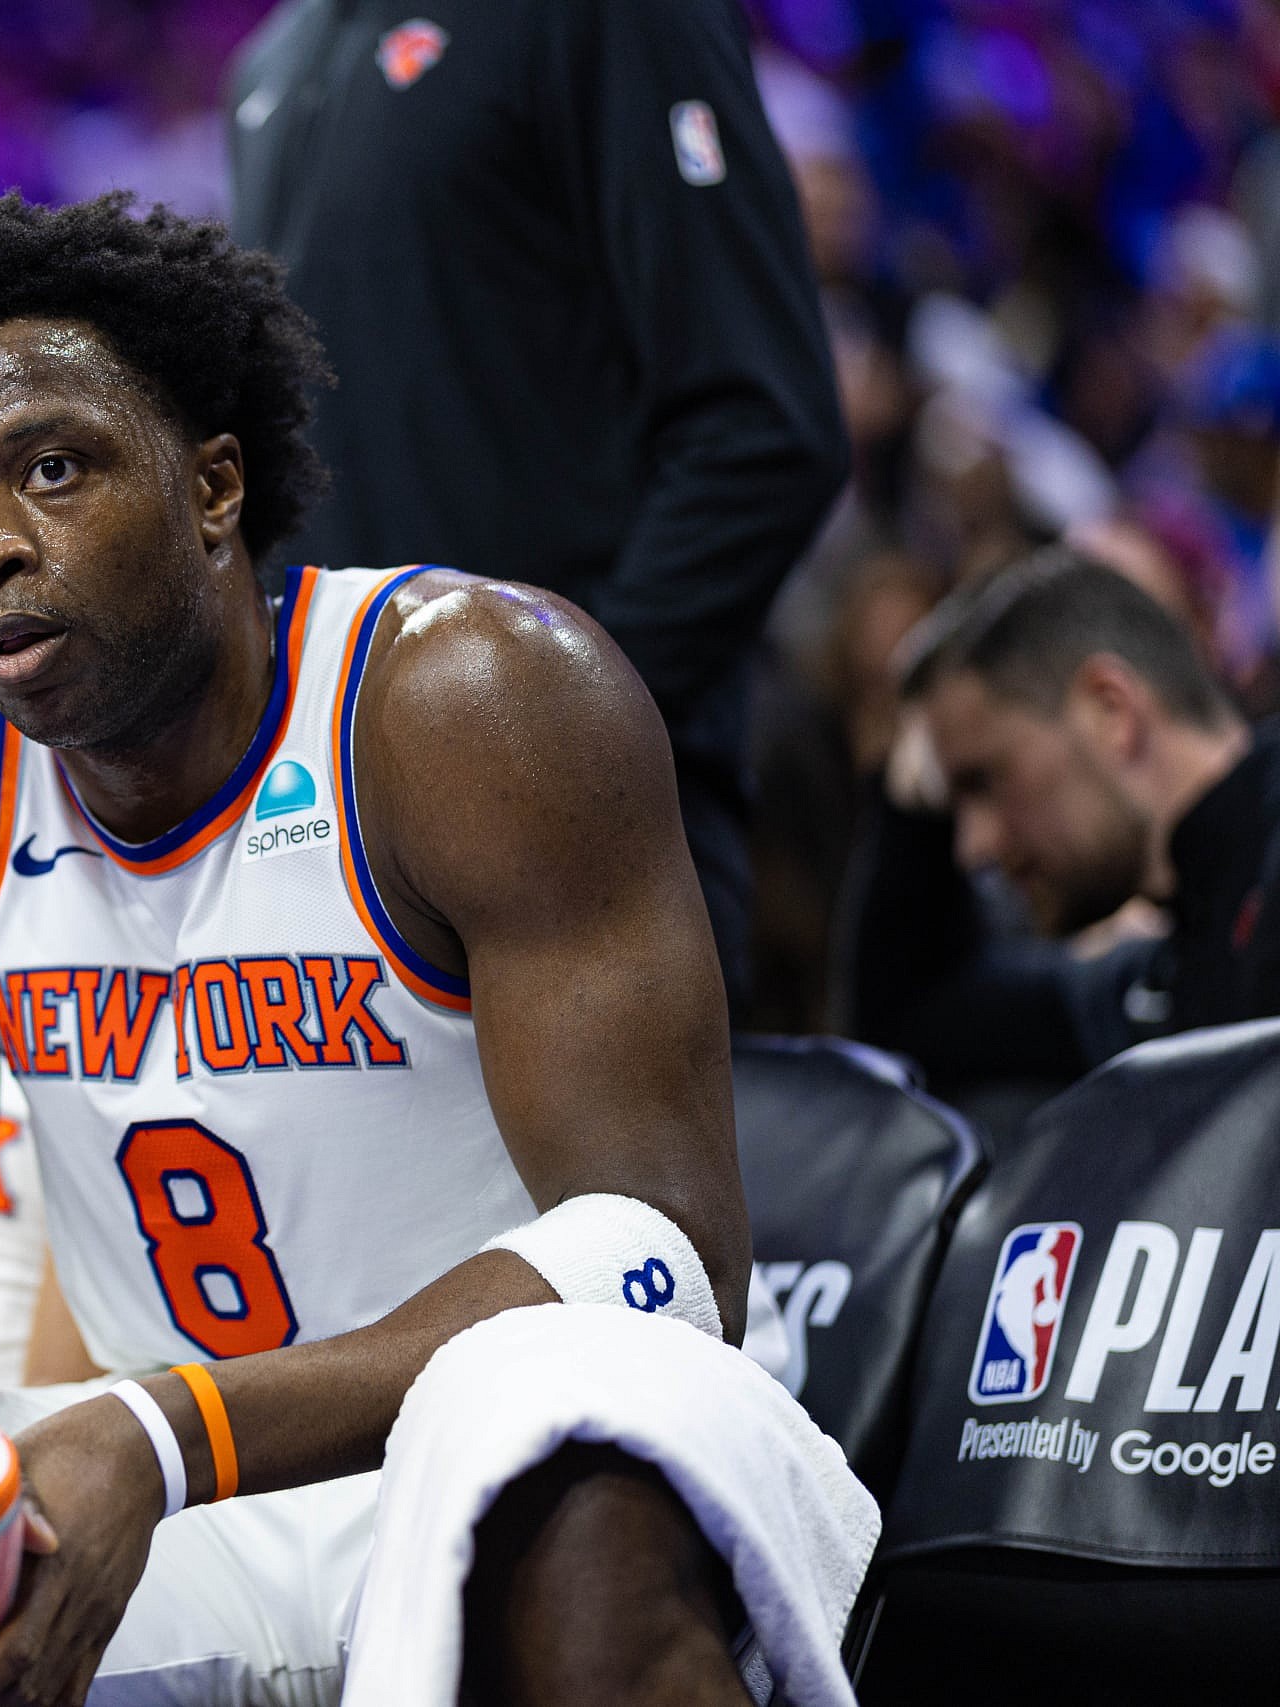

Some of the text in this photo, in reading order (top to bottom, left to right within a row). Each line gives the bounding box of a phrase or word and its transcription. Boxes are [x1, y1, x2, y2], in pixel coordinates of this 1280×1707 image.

[247, 819, 330, 856] sphere
[115, 1118, 299, 1361] 8
[622, 1257, 675, 1313] 8
[1064, 1220, 1280, 1413] PLA
[981, 1358, 1021, 1392] NBA
[957, 1416, 1277, 1488] Presented by Google
